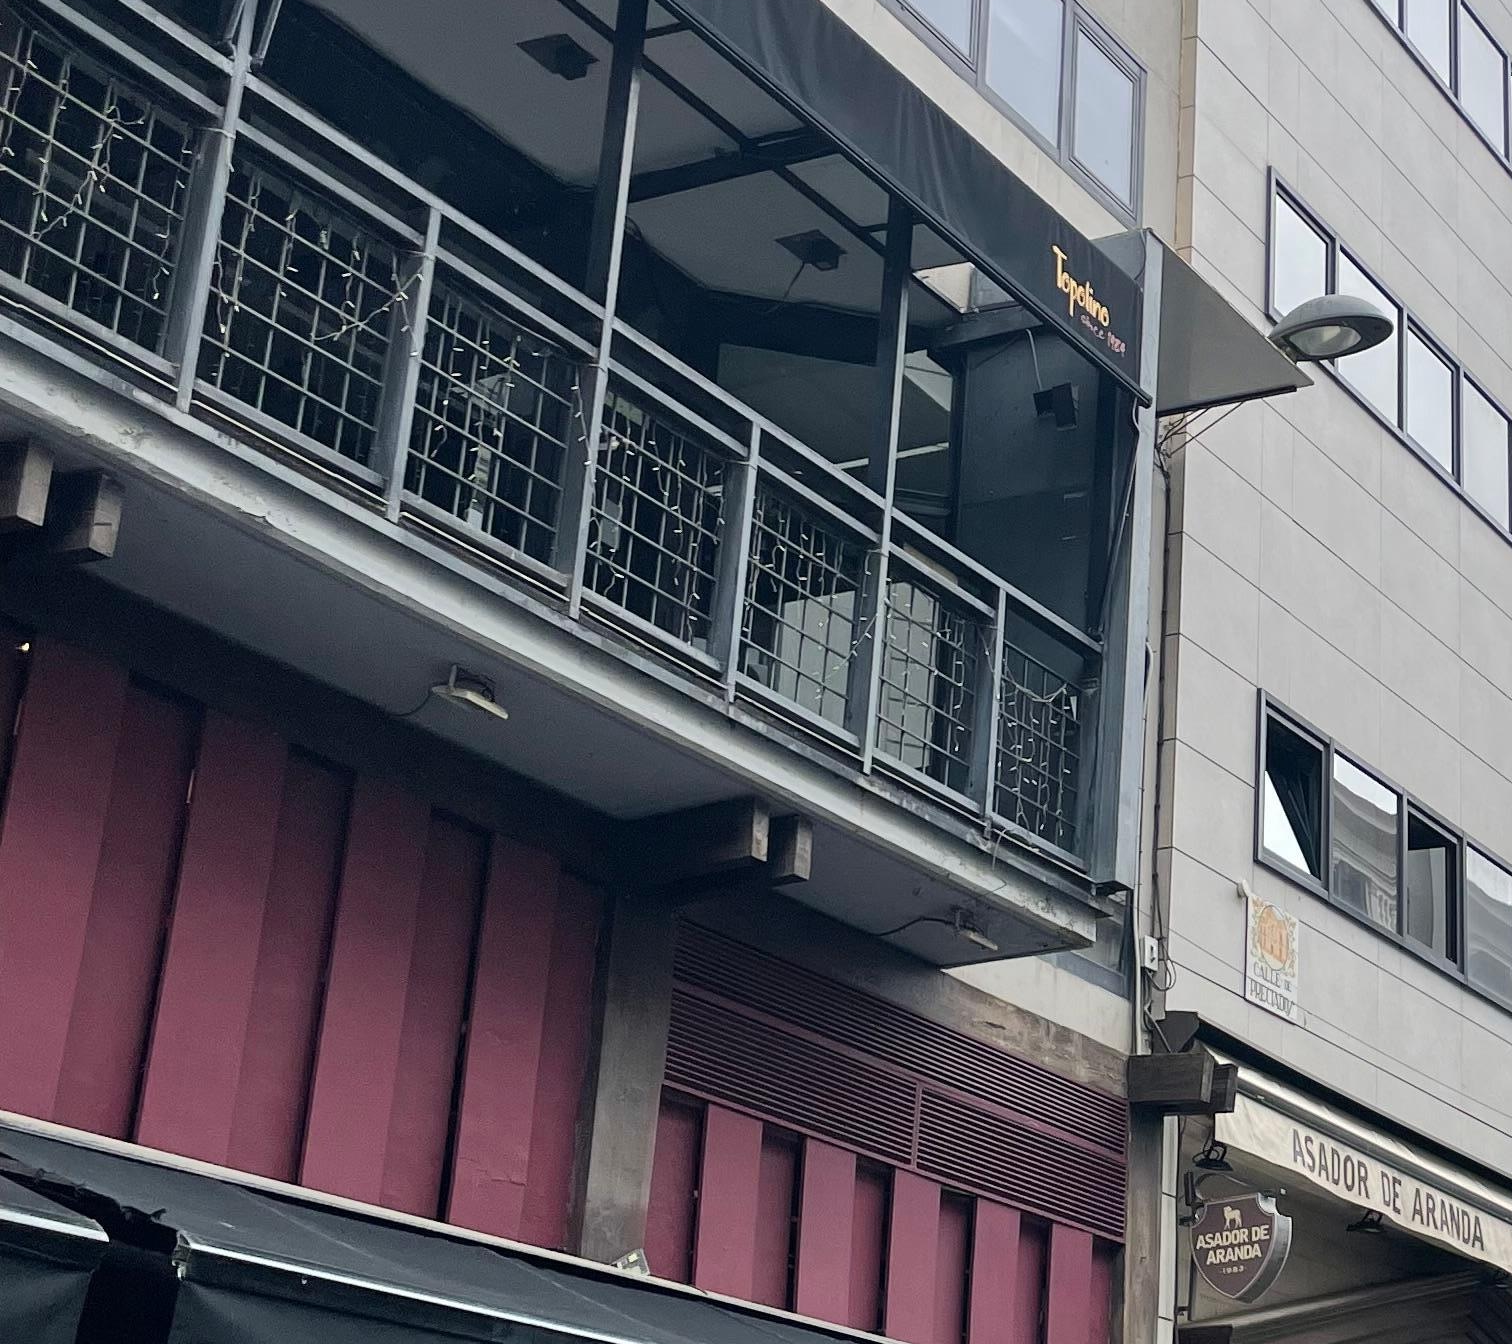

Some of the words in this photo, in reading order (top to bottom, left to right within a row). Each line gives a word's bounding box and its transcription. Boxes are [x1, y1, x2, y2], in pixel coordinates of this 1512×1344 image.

[1052, 244, 1109, 327] Topolino
[1253, 960, 1281, 989] CALLE
[1292, 1128, 1371, 1200] ASADOR
[1380, 1170, 1402, 1215] DE
[1411, 1187, 1485, 1252] ARANDA
[1196, 1228, 1249, 1250] ASADOR
[1252, 1224, 1271, 1242] DE
[1206, 1243, 1262, 1265] ARANDA
